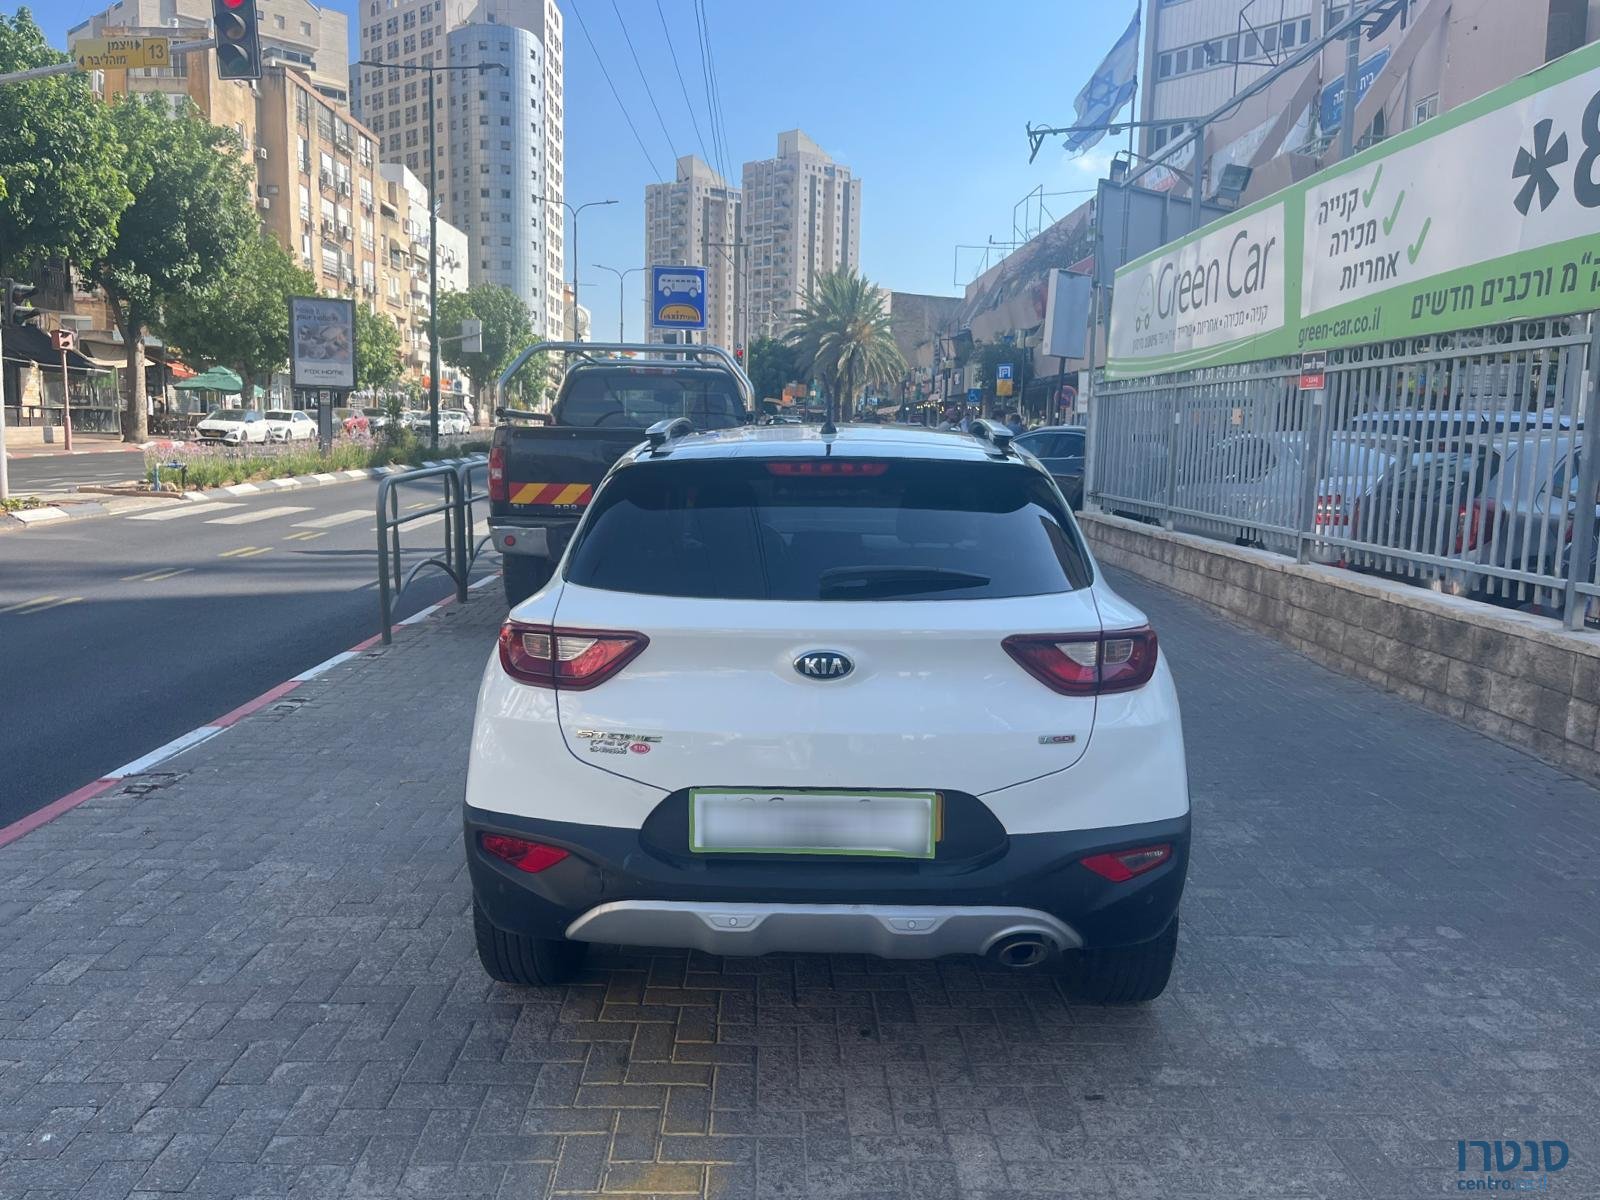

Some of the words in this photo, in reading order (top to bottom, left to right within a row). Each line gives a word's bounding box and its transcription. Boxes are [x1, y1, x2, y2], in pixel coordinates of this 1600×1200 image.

[107, 40, 133, 54] ויצמן
[148, 44, 164, 60] 13
[1318, 188, 1359, 225] קנייה
[1329, 218, 1377, 257] מכירה
[1157, 260, 1220, 320] Green
[1226, 230, 1276, 299] Car
[1339, 251, 1400, 291] אחריות
[1480, 267, 1553, 307] ורכבים
[1410, 284, 1475, 320] חדשים
[1298, 306, 1381, 348] green-car.co.il
[804, 657, 845, 674] KIA
